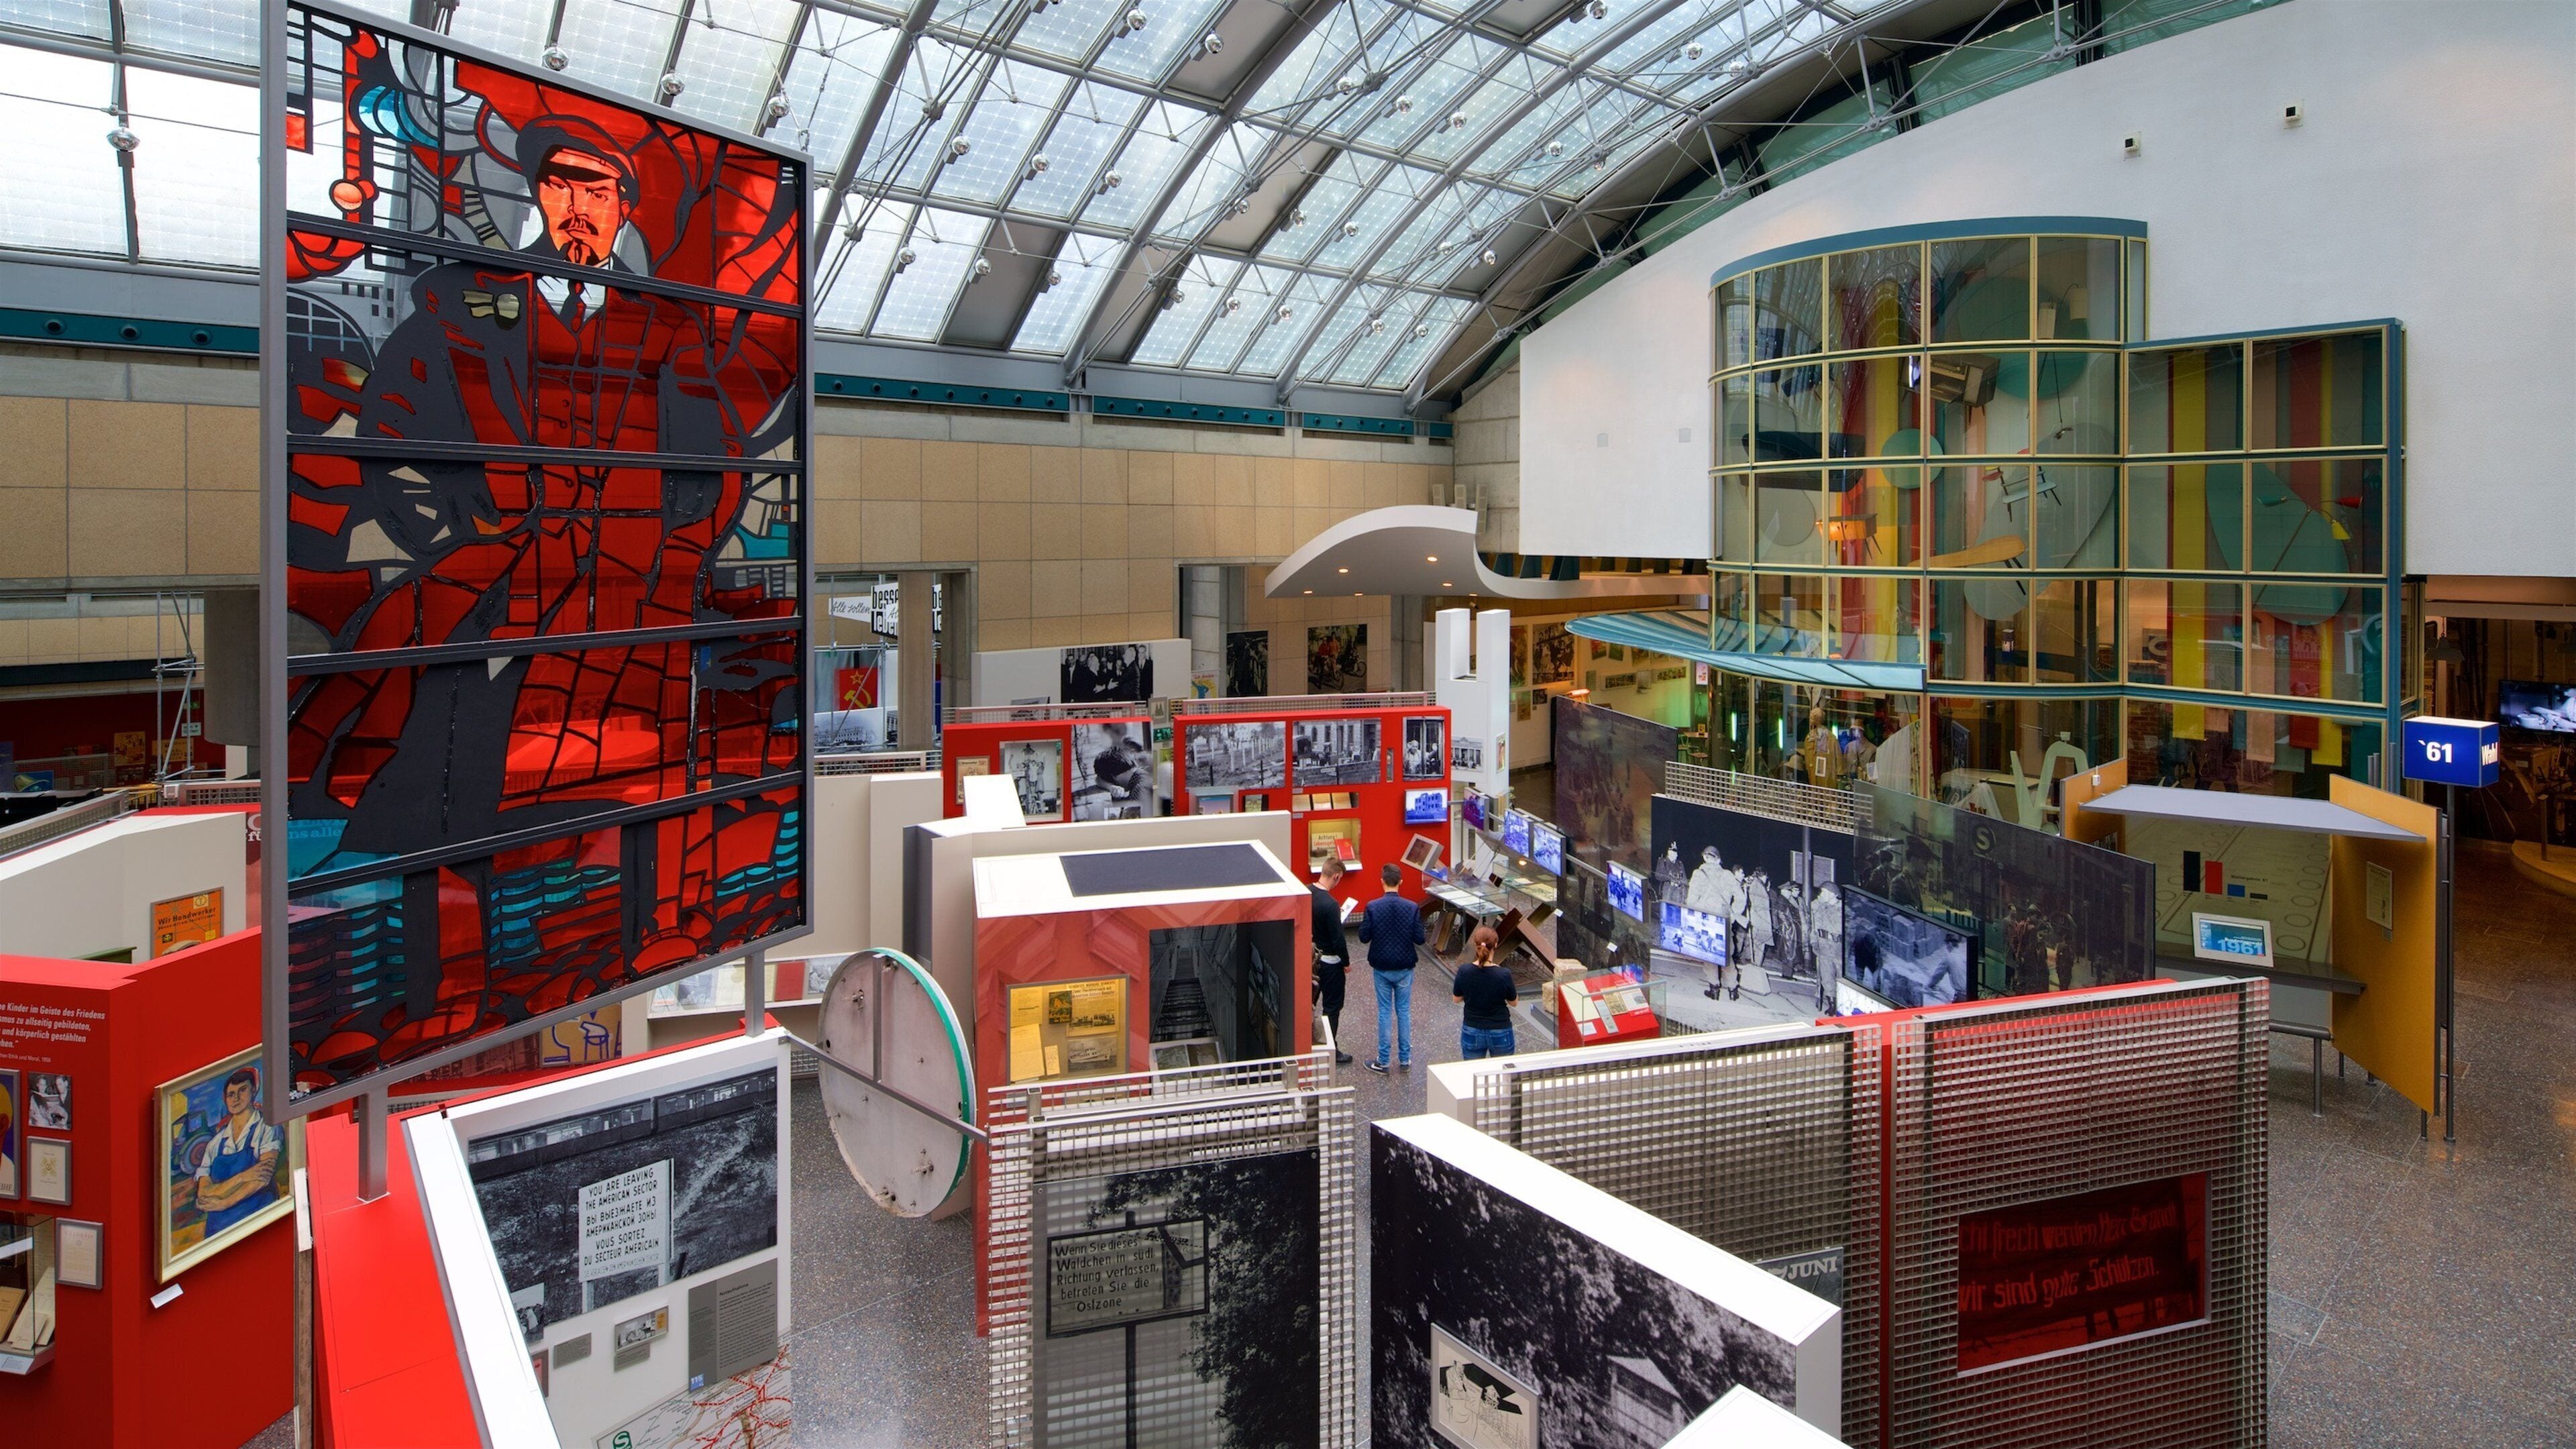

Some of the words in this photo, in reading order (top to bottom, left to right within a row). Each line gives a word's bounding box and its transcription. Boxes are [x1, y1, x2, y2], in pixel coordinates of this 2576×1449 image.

[848, 602, 871, 613] sollen
[2481, 741, 2498, 766] Wahl
[1976, 827, 1990, 850] S
[158, 917, 171, 925] Wir
[173, 908, 216, 921] Handwerker
[2217, 939, 2263, 955] 1961
[7, 1002, 28, 1013] Kinder
[30, 1005, 38, 1014] im
[40, 1006, 61, 1016] Geiste
[62, 1009, 74, 1017] des
[76, 1009, 105, 1020] Friedens
[2, 1028, 15, 1036] und
[15, 1028, 50, 1039] körperlich
[51, 1033, 87, 1043] gestählten
[25, 1017, 52, 1029] allseitig
[54, 1020, 91, 1032] gebildeten,
[589, 1185, 602, 1197] YOU
[606, 1179, 620, 1192] ARE
[624, 1168, 654, 1186] LEAVING
[586, 1200, 596, 1211] THE
[598, 1189, 630, 1208] AMERICAN
[633, 1180, 657, 1196] SECTOR
[586, 1214, 597, 1226] ВЫ
[600, 1201, 642, 1222] ВЫЕЗЖАЕТЕ
[647, 1196, 656, 1207] ИЗ
[586, 1214, 635, 1238] АМЕРИКАНСКОЙ
[638, 1210, 656, 1224] ЗОНЫ
[1992, 1220, 2039, 1259] frech
[2098, 1211, 2128, 1244] Herr
[596, 1236, 614, 1250] VOUS
[619, 1228, 645, 1244] SORTEZ
[1055, 1245, 1087, 1256] Wenn
[1089, 1242, 1106, 1252] Sie
[1108, 1238, 1138, 1250] dieses
[584, 1256, 592, 1266] DU
[595, 1248, 621, 1263] SECTEUR
[625, 1238, 659, 1254] AMERICAIN
[1116, 1252, 1125, 1263] in
[1134, 1247, 1155, 1261] südl.
[1057, 1271, 1101, 1286] Richtung
[1107, 1263, 1159, 1279] verlassen,
[1788, 1256, 1837, 1279] JUNI
[1061, 1285, 1104, 1300] betreten
[1110, 1281, 1127, 1293] Sie
[1134, 1277, 1149, 1289] die
[1994, 1271, 2037, 1309] sind
[2042, 1270, 2079, 1308] gute
[2086, 1254, 2160, 1291] Schützen.
[1077, 1297, 1122, 1312] Ostzone
